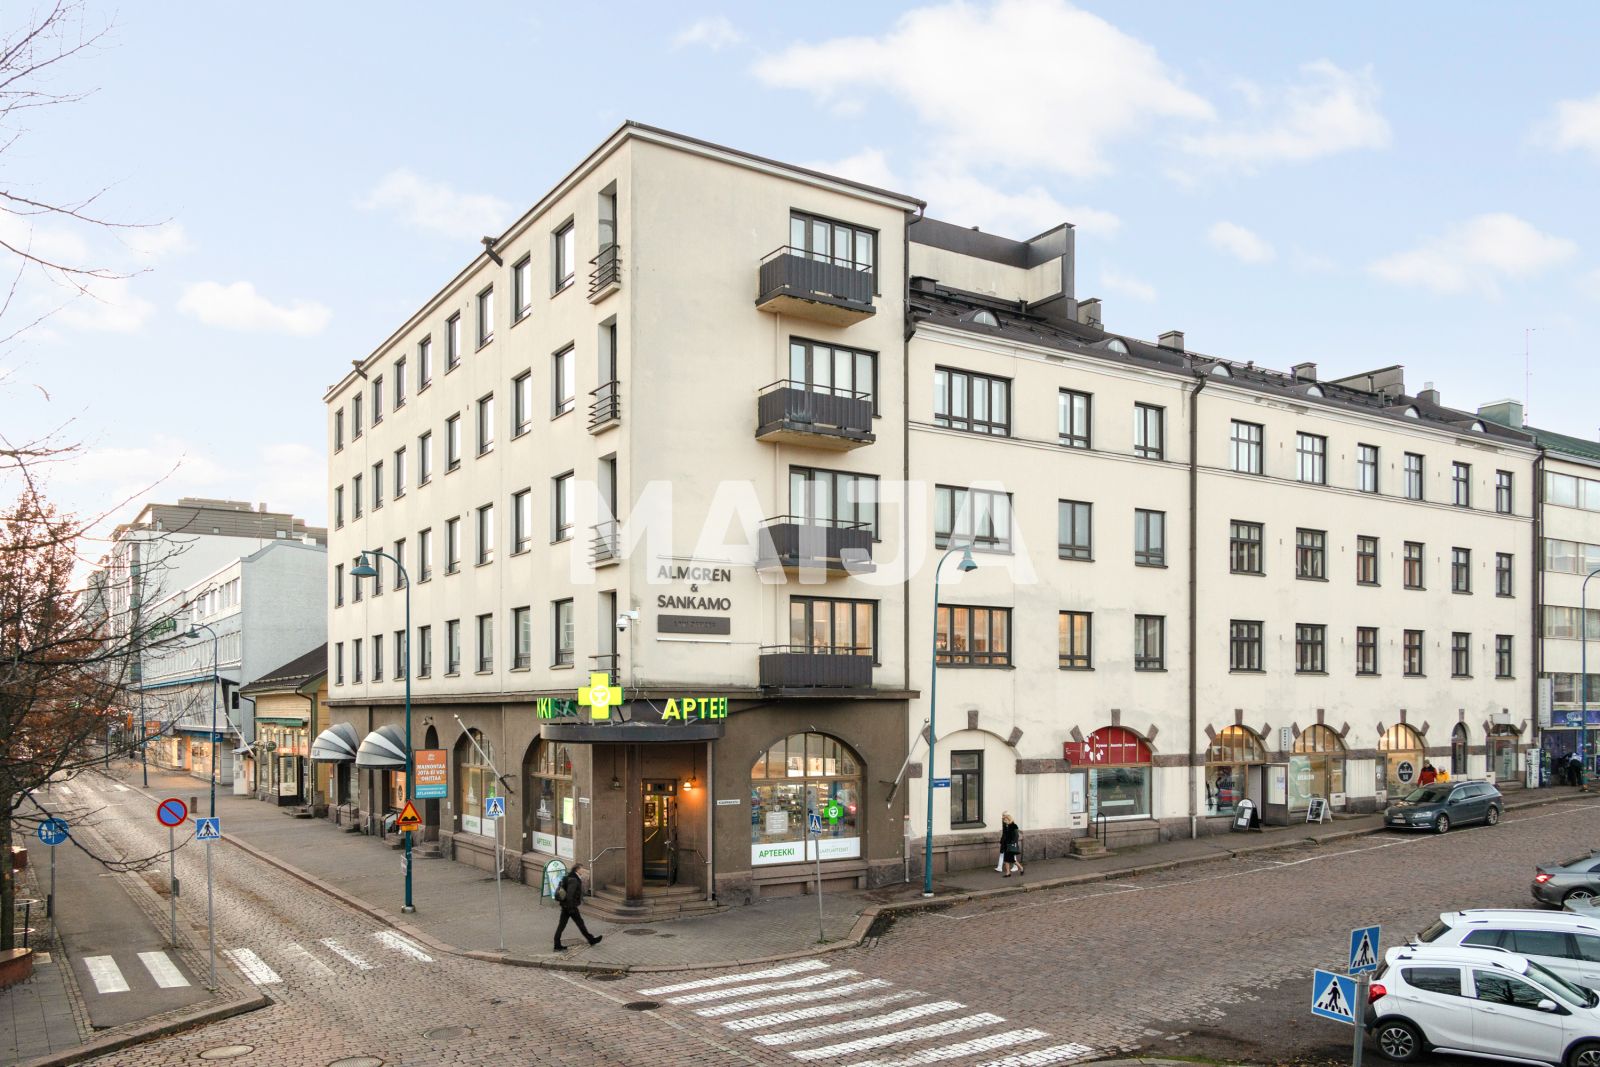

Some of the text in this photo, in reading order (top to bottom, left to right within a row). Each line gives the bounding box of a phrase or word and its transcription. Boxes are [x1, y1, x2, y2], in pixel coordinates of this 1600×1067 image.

[657, 565, 731, 582] ALMGREN
[690, 583, 698, 593] &
[657, 594, 731, 611] SANKAMO
[661, 697, 728, 720] APTEE
[758, 848, 794, 858] APTEEKKI
